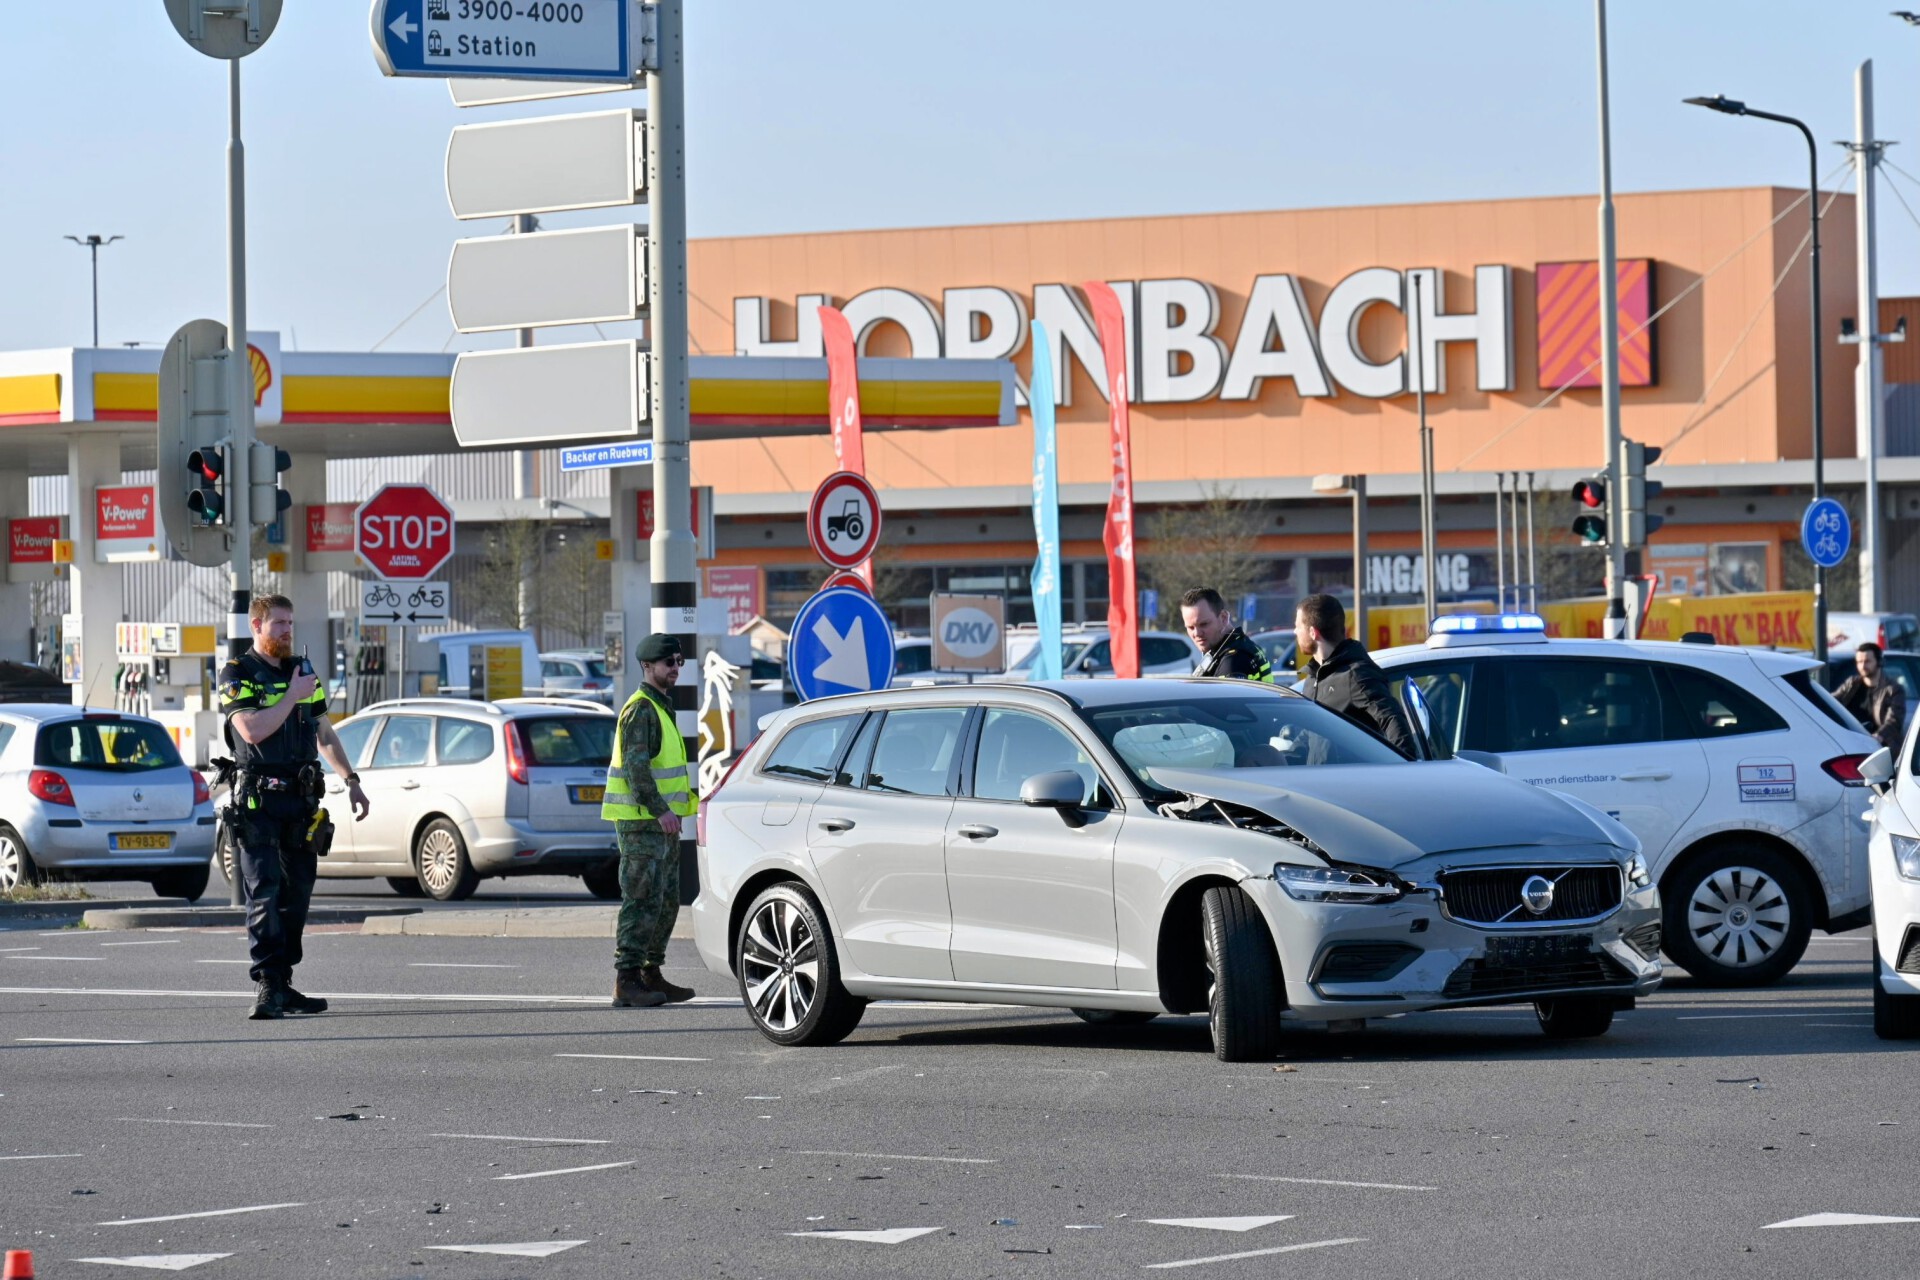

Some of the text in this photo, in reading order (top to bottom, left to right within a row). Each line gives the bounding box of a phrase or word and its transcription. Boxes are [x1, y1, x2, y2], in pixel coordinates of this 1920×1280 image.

[457, 0, 583, 24] 3900-4000
[457, 34, 536, 57] Station
[734, 264, 1513, 406] HORNBACH
[566, 445, 649, 464] Backer en Ruebweg
[102, 505, 147, 521] V-Power
[14, 534, 52, 548] V-Power
[362, 515, 448, 549] STOP
[944, 621, 994, 644] DKV
[1695, 613, 1740, 645] PAK
[1757, 610, 1803, 644] BAK
[1544, 776, 1557, 785] en
[1558, 773, 1609, 784] dienstbaar
[1759, 768, 1774, 777] 112
[118, 835, 167, 848] TV-983-G
